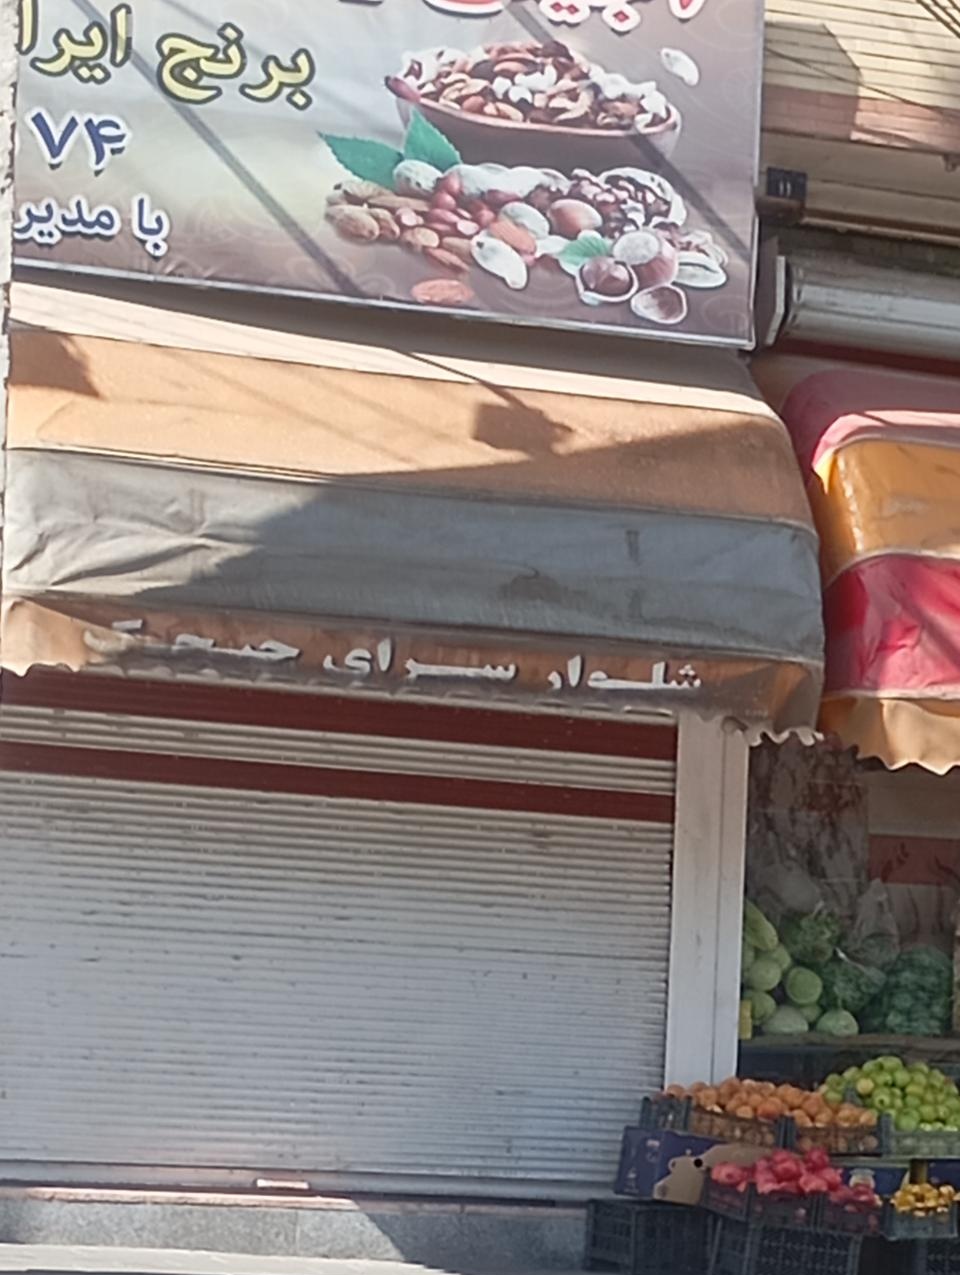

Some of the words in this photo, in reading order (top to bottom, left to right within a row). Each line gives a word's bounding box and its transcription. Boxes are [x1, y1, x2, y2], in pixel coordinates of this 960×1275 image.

[156, 22, 316, 110] برنج
[29, 109, 128, 171] ۷۴
[135, 195, 168, 254] با
[322, 637, 518, 682] سرای
